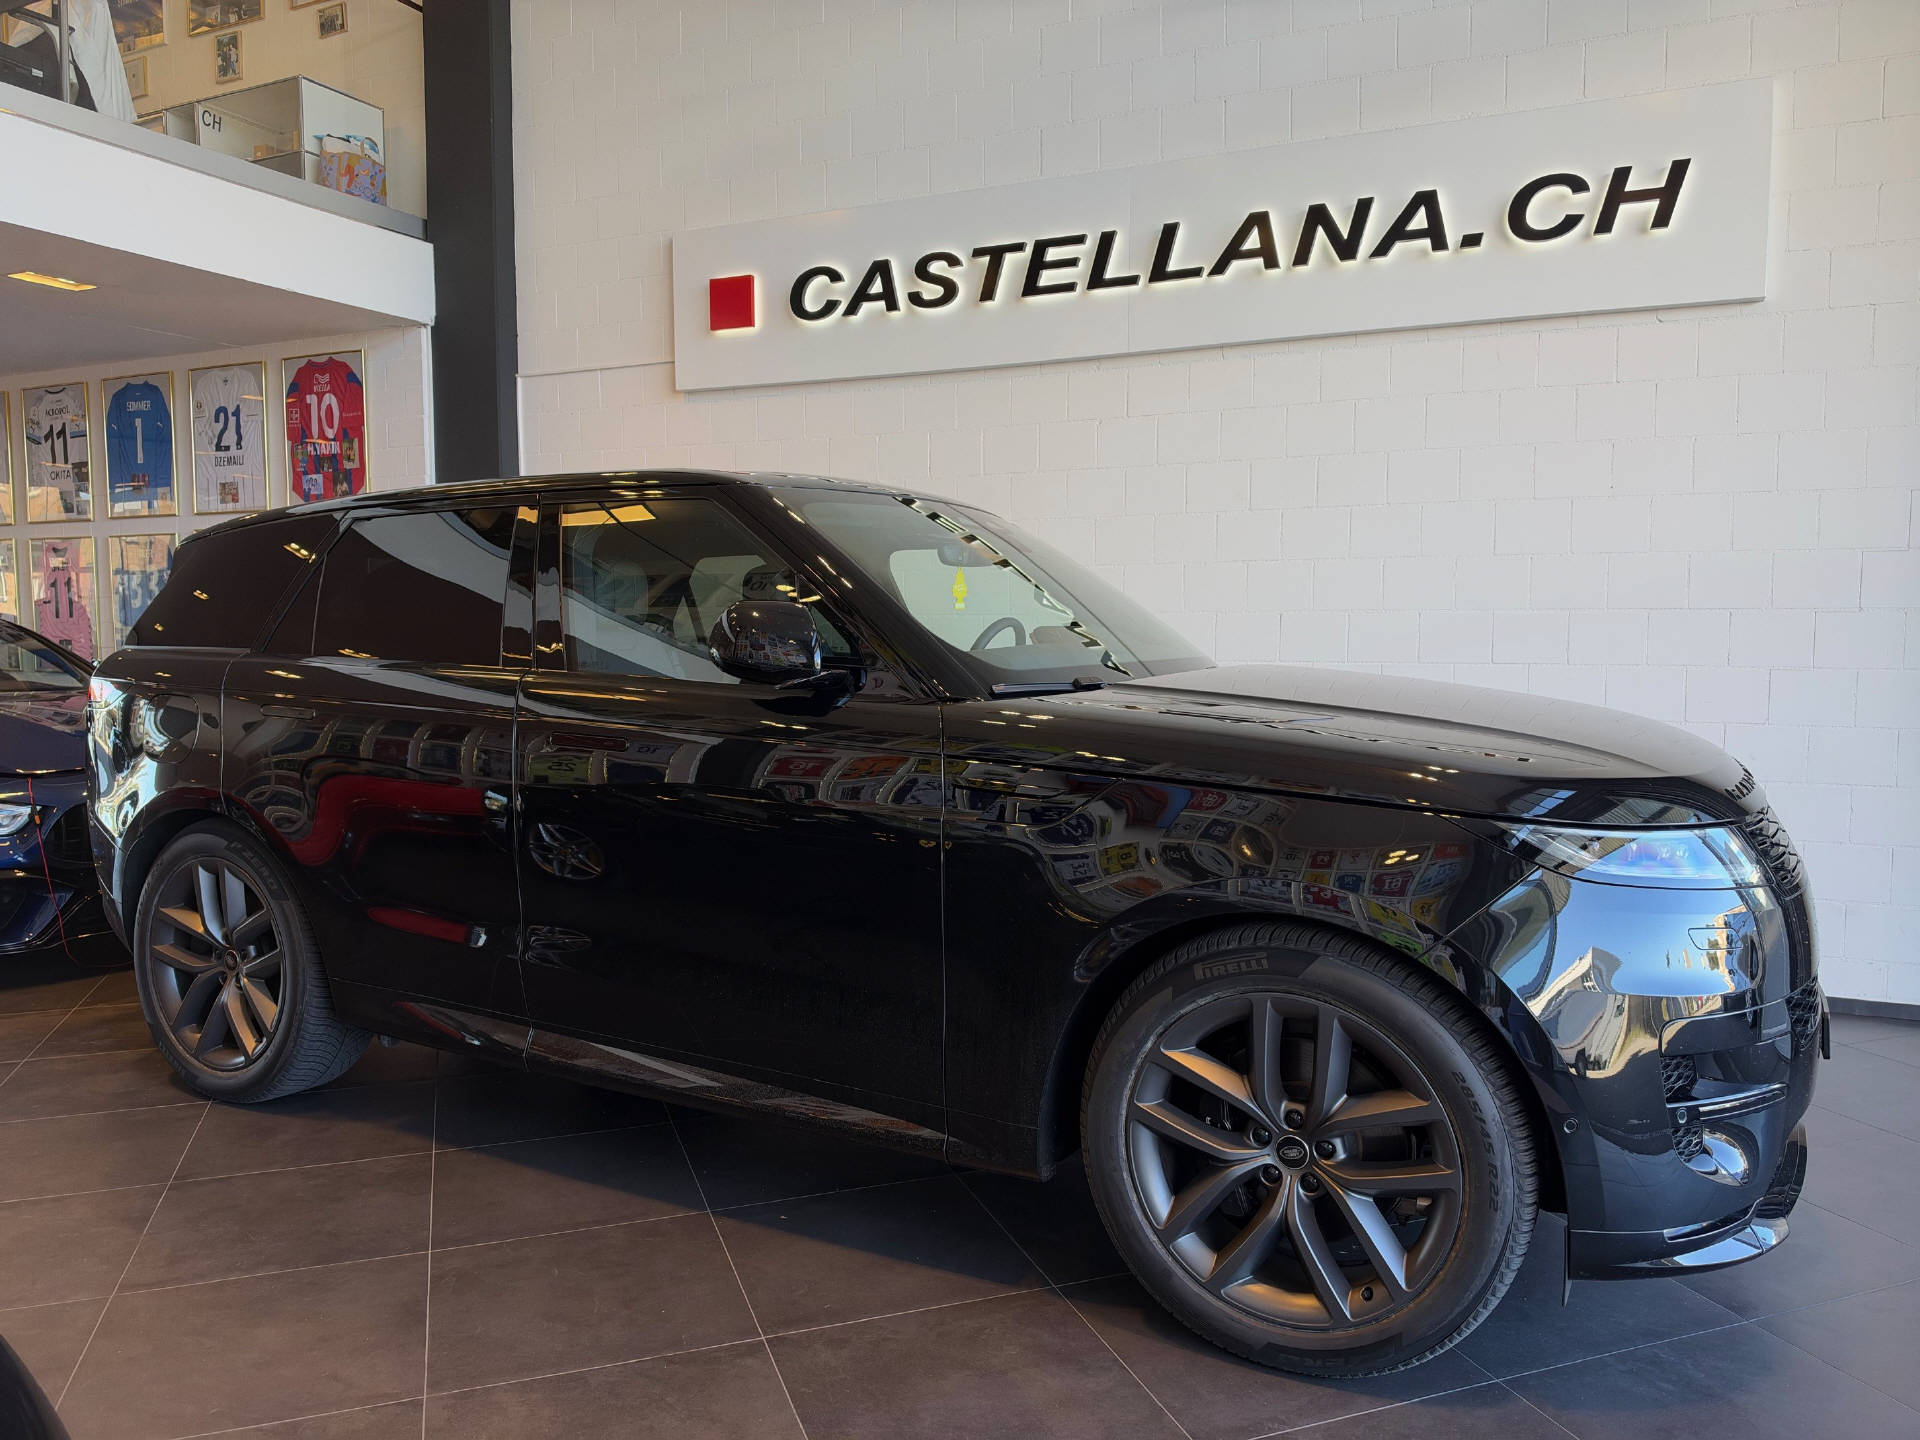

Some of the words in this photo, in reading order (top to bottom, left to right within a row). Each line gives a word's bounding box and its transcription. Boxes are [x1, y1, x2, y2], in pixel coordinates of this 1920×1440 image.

[202, 109, 221, 132] CH
[790, 158, 1691, 322] CASTELLANA.CH
[127, 400, 152, 412] SOMMER
[306, 392, 340, 440] 10
[43, 422, 68, 465] 11
[135, 417, 144, 464] 1
[214, 404, 243, 452] 21
[49, 469, 72, 481] OKITA
[50, 576, 74, 619] 11
[1194, 952, 1268, 981] PIRELLI
